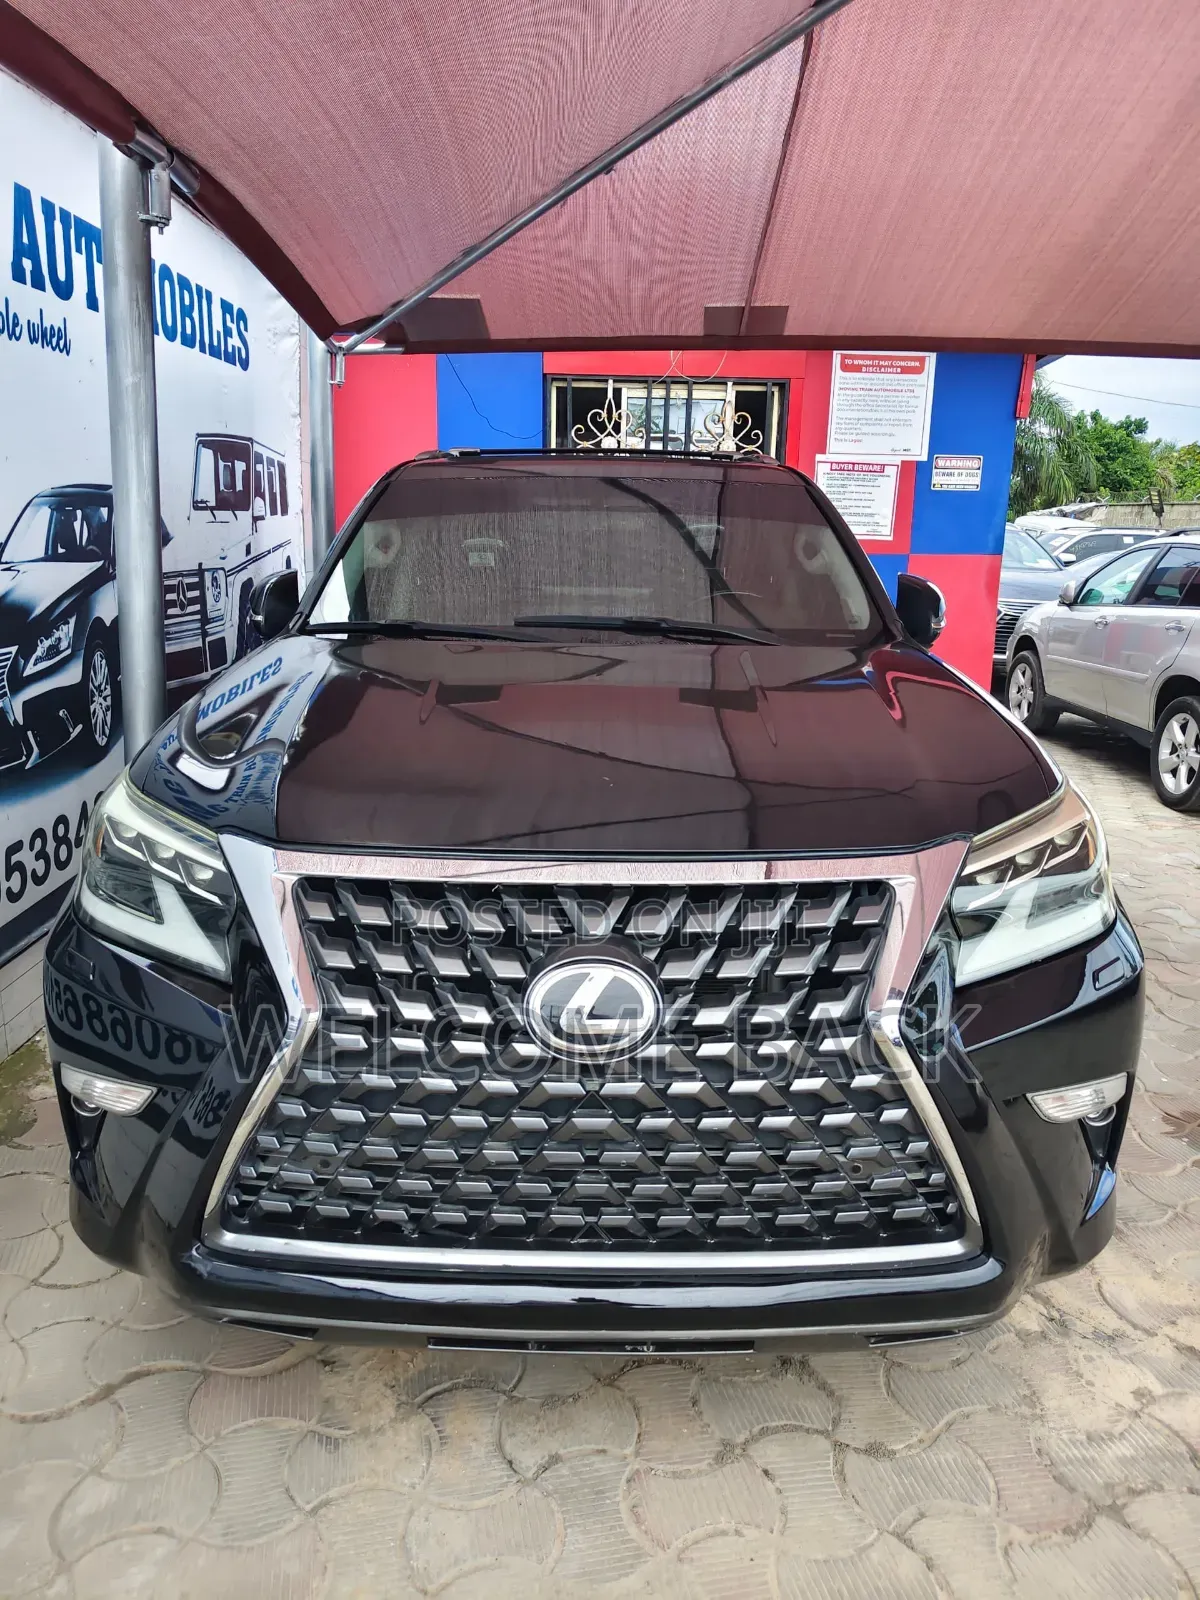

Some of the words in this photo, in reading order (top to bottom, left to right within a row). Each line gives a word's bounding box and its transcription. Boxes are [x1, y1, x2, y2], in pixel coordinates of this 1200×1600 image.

[27, 308, 71, 357] wheel
[854, 464, 884, 472] BEWARE!
[938, 459, 979, 468] WARNING
